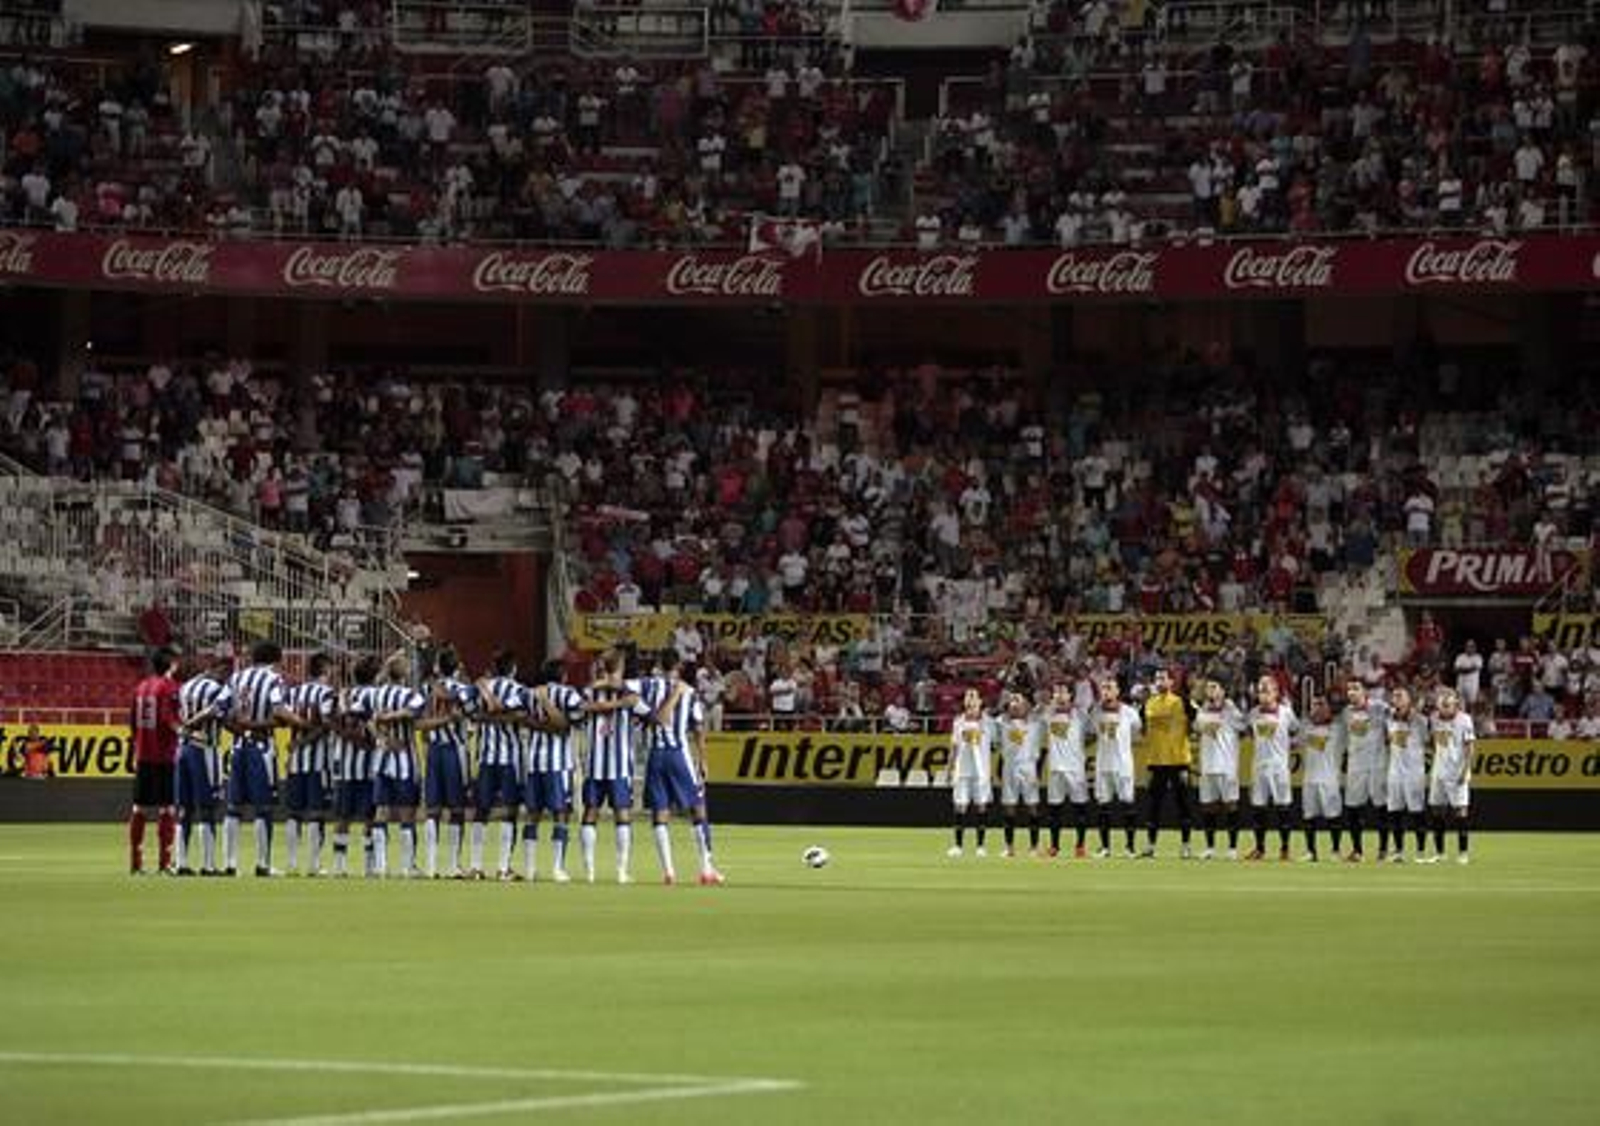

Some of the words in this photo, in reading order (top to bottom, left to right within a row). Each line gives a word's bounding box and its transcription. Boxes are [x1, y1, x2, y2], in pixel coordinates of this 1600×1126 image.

[103, 242, 215, 281] Coca-Cola
[284, 246, 402, 288] Coca-Cola
[474, 253, 593, 293] Coca-Cola
[667, 255, 785, 295] Coca-Cola
[859, 256, 978, 296] Coca-Cola
[1047, 252, 1158, 292] Coca-Cola
[1225, 246, 1338, 287] Coca-Cola
[1406, 240, 1522, 282] Coca-Cola
[1470, 750, 1570, 777] uestro
